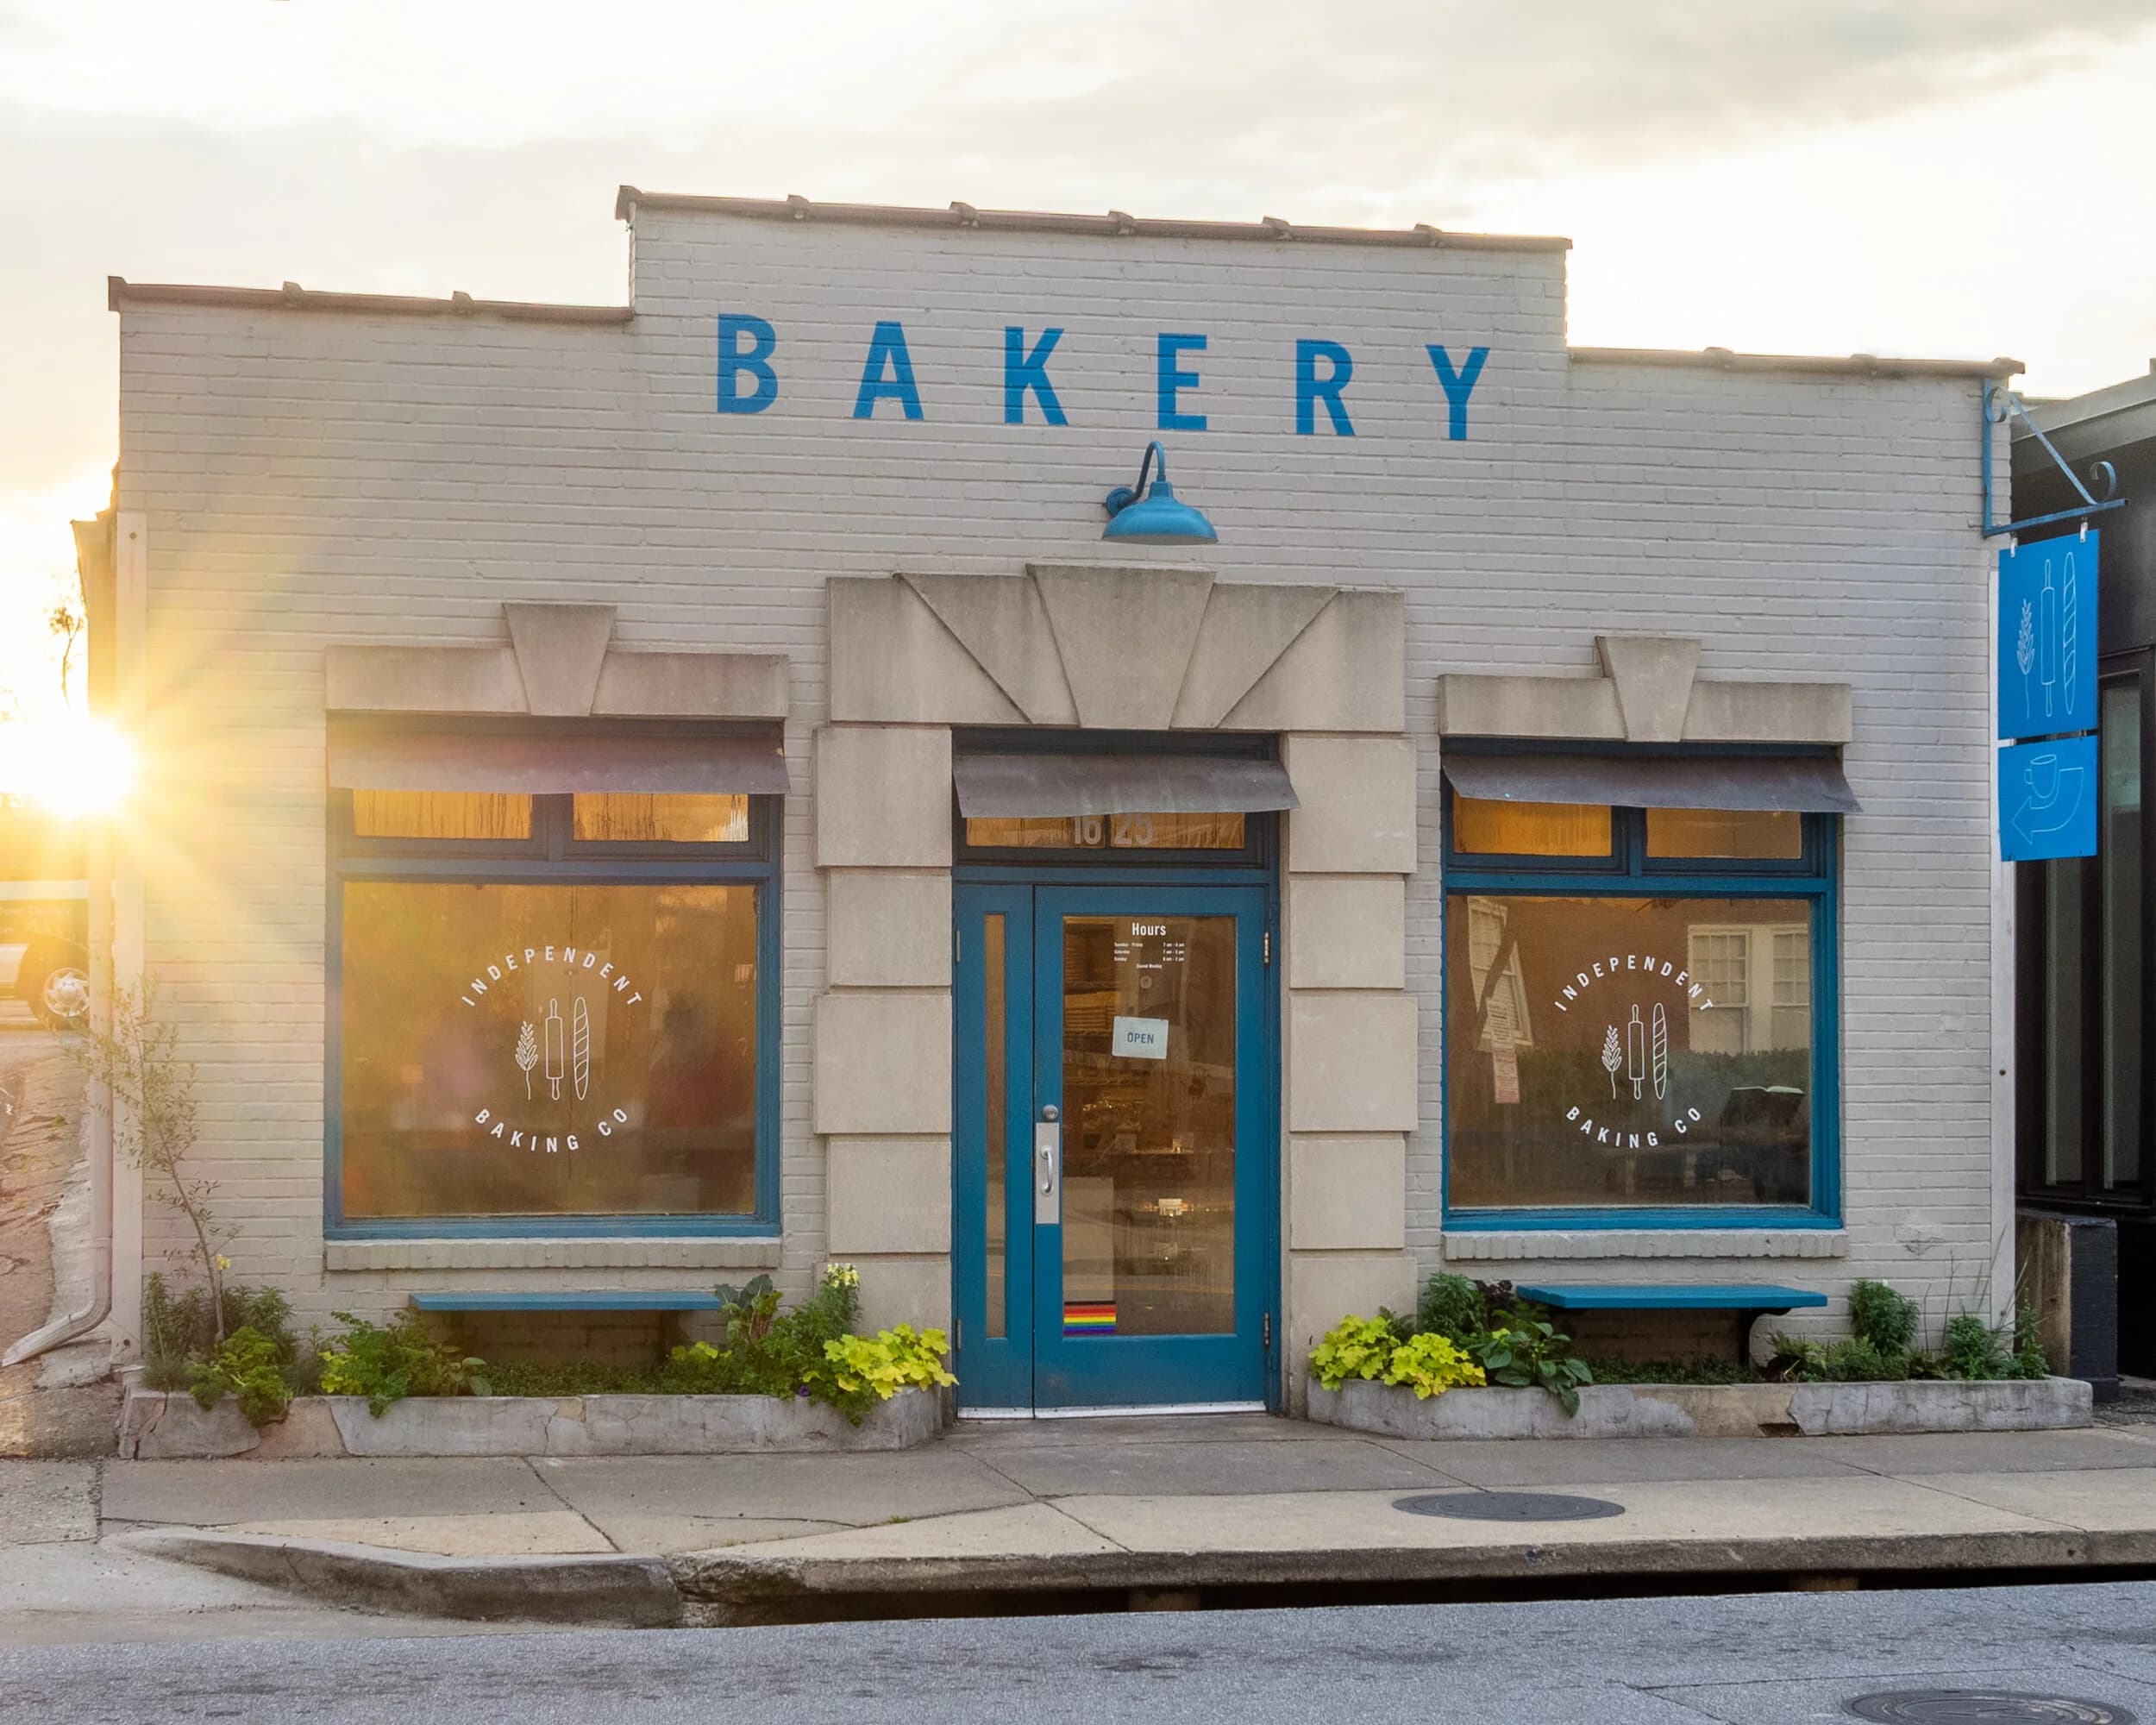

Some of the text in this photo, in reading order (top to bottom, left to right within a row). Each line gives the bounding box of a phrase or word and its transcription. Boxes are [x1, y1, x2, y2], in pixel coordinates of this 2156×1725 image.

[718, 314, 1490, 441] BAKERY
[1131, 922, 1167, 936] Hours
[461, 945, 642, 1007] INDEPENDENT
[1554, 954, 1714, 1012] INDEPENDENT
[1126, 1032, 1155, 1044] OPEN
[474, 1107, 628, 1153] BAKING CO
[1565, 1106, 1702, 1150] BAKING CO
